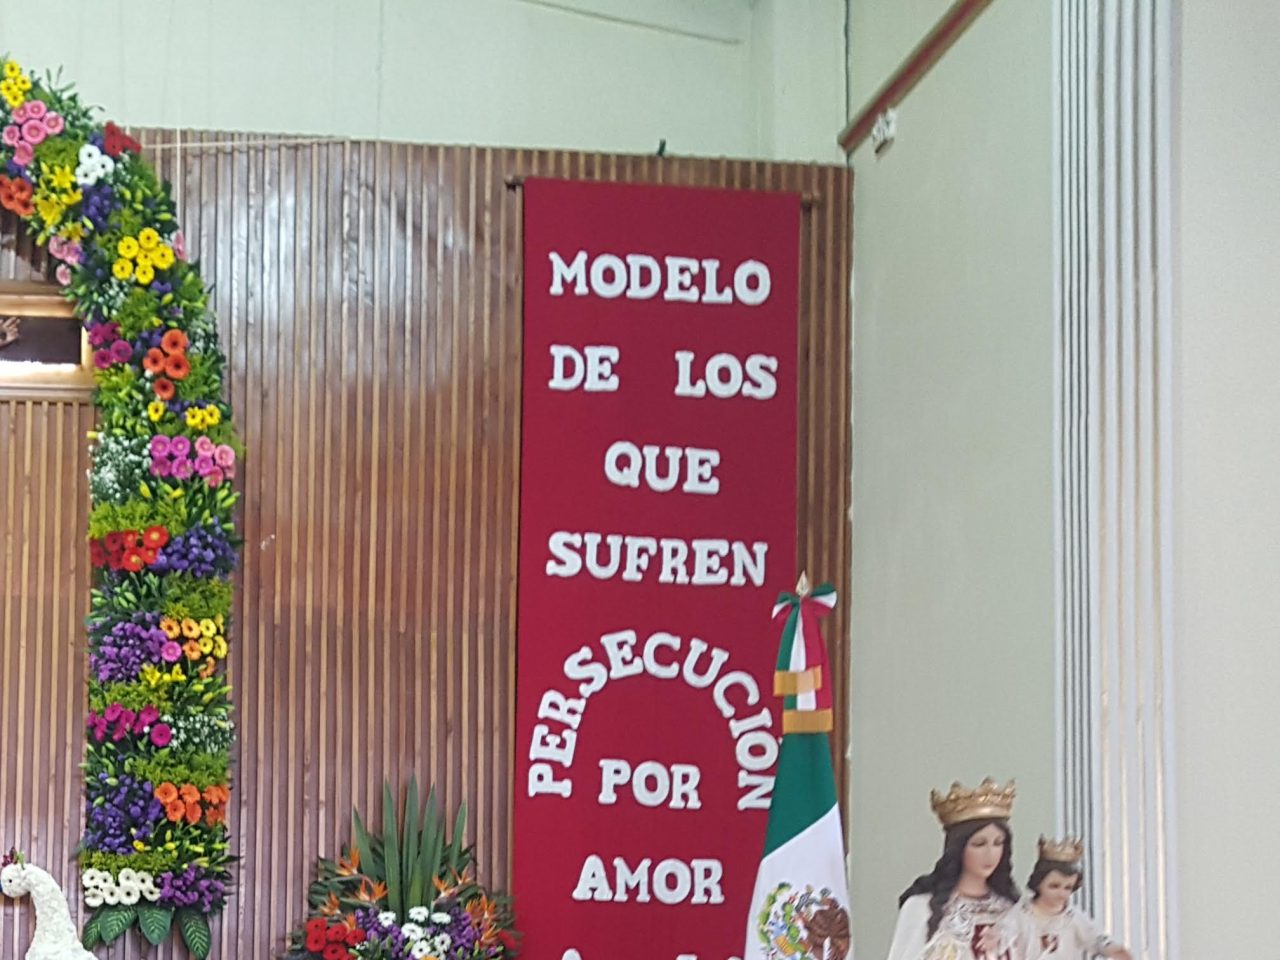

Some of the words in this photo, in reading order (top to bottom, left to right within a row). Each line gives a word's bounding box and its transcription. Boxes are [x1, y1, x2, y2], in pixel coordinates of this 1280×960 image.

[548, 250, 772, 305] MODELO
[548, 344, 620, 392] DE
[674, 350, 778, 400] LOS
[604, 441, 721, 494] QUE
[545, 531, 768, 587] SUFREN
[598, 758, 702, 809] POR
[571, 854, 725, 904] AMOR
